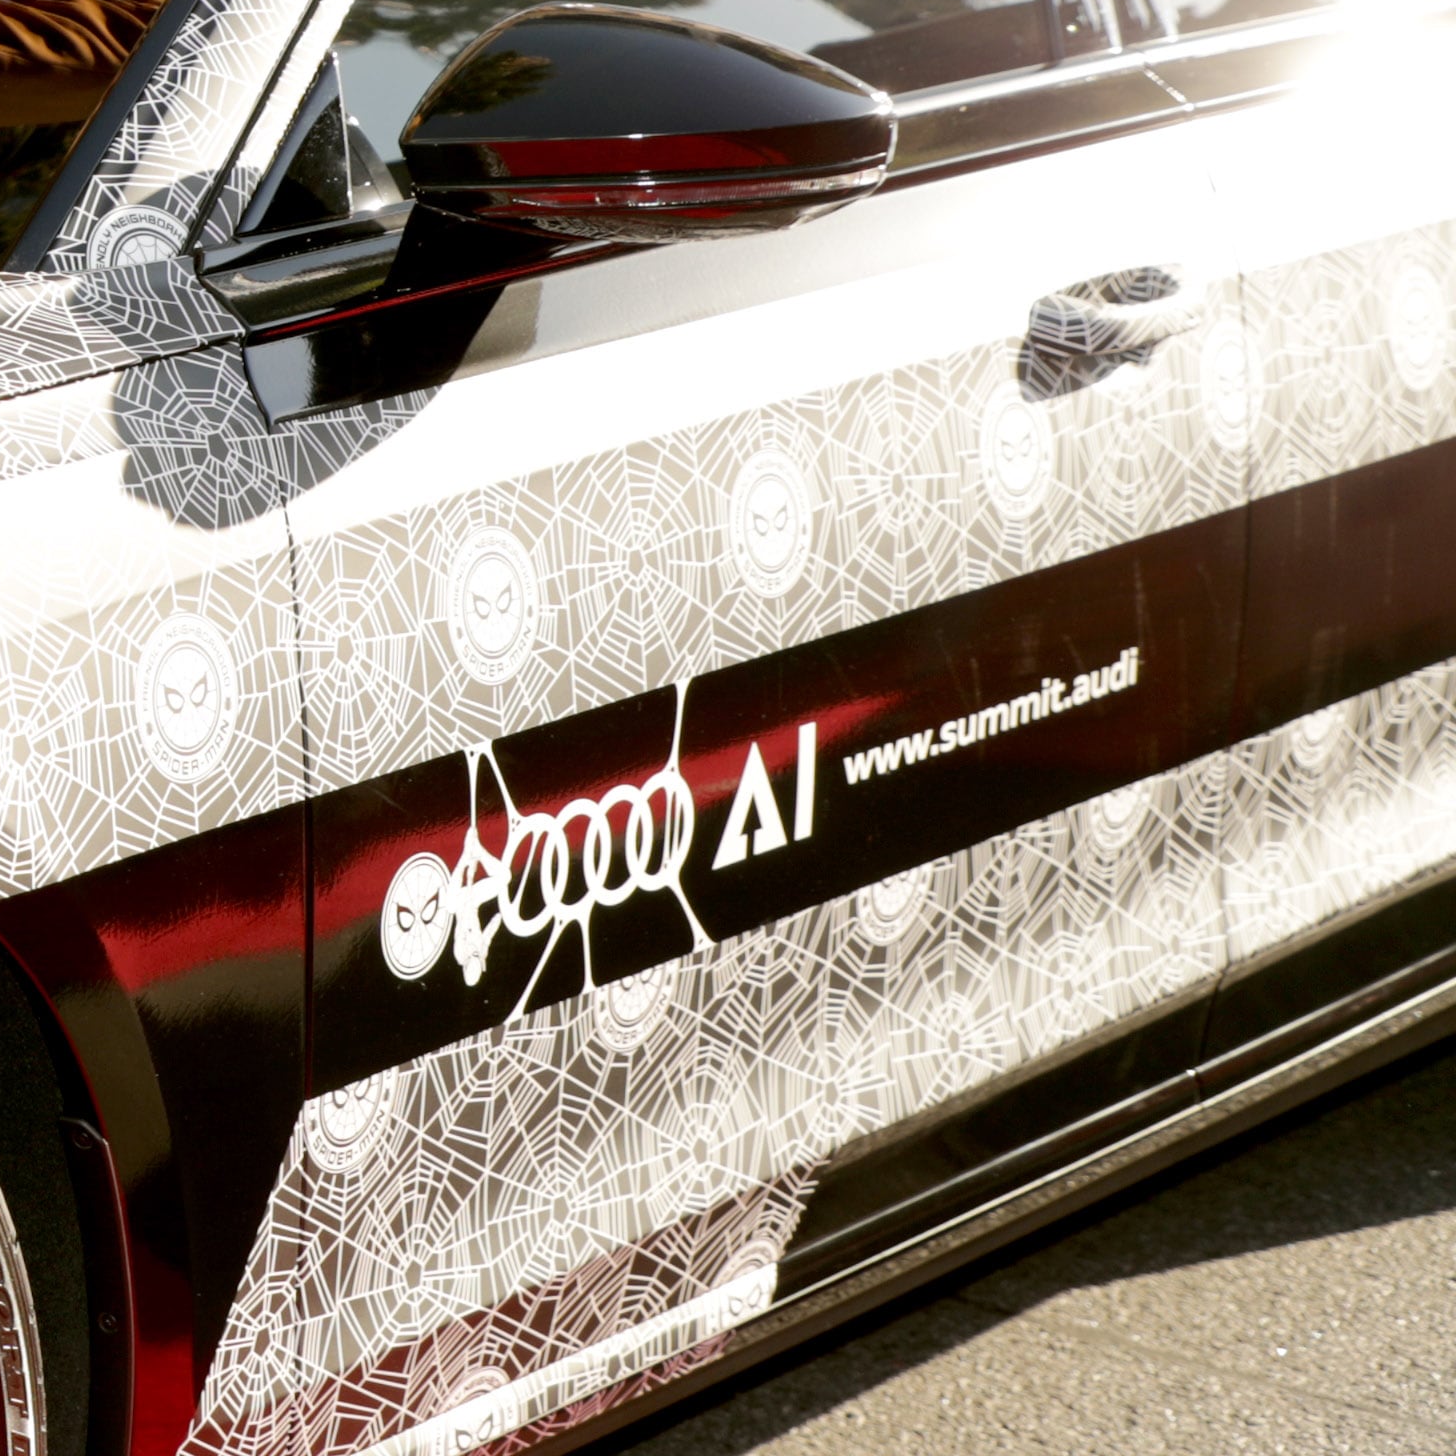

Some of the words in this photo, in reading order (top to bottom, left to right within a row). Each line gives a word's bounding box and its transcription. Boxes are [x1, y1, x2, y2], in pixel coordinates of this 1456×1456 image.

[110, 213, 186, 245] NEIGHBORH
[843, 647, 1138, 786] www.summit.audi
[151, 718, 231, 777] SPIDER-MAN
[712, 721, 817, 870] AI
[312, 1109, 386, 1167] SPIDER-MAN
